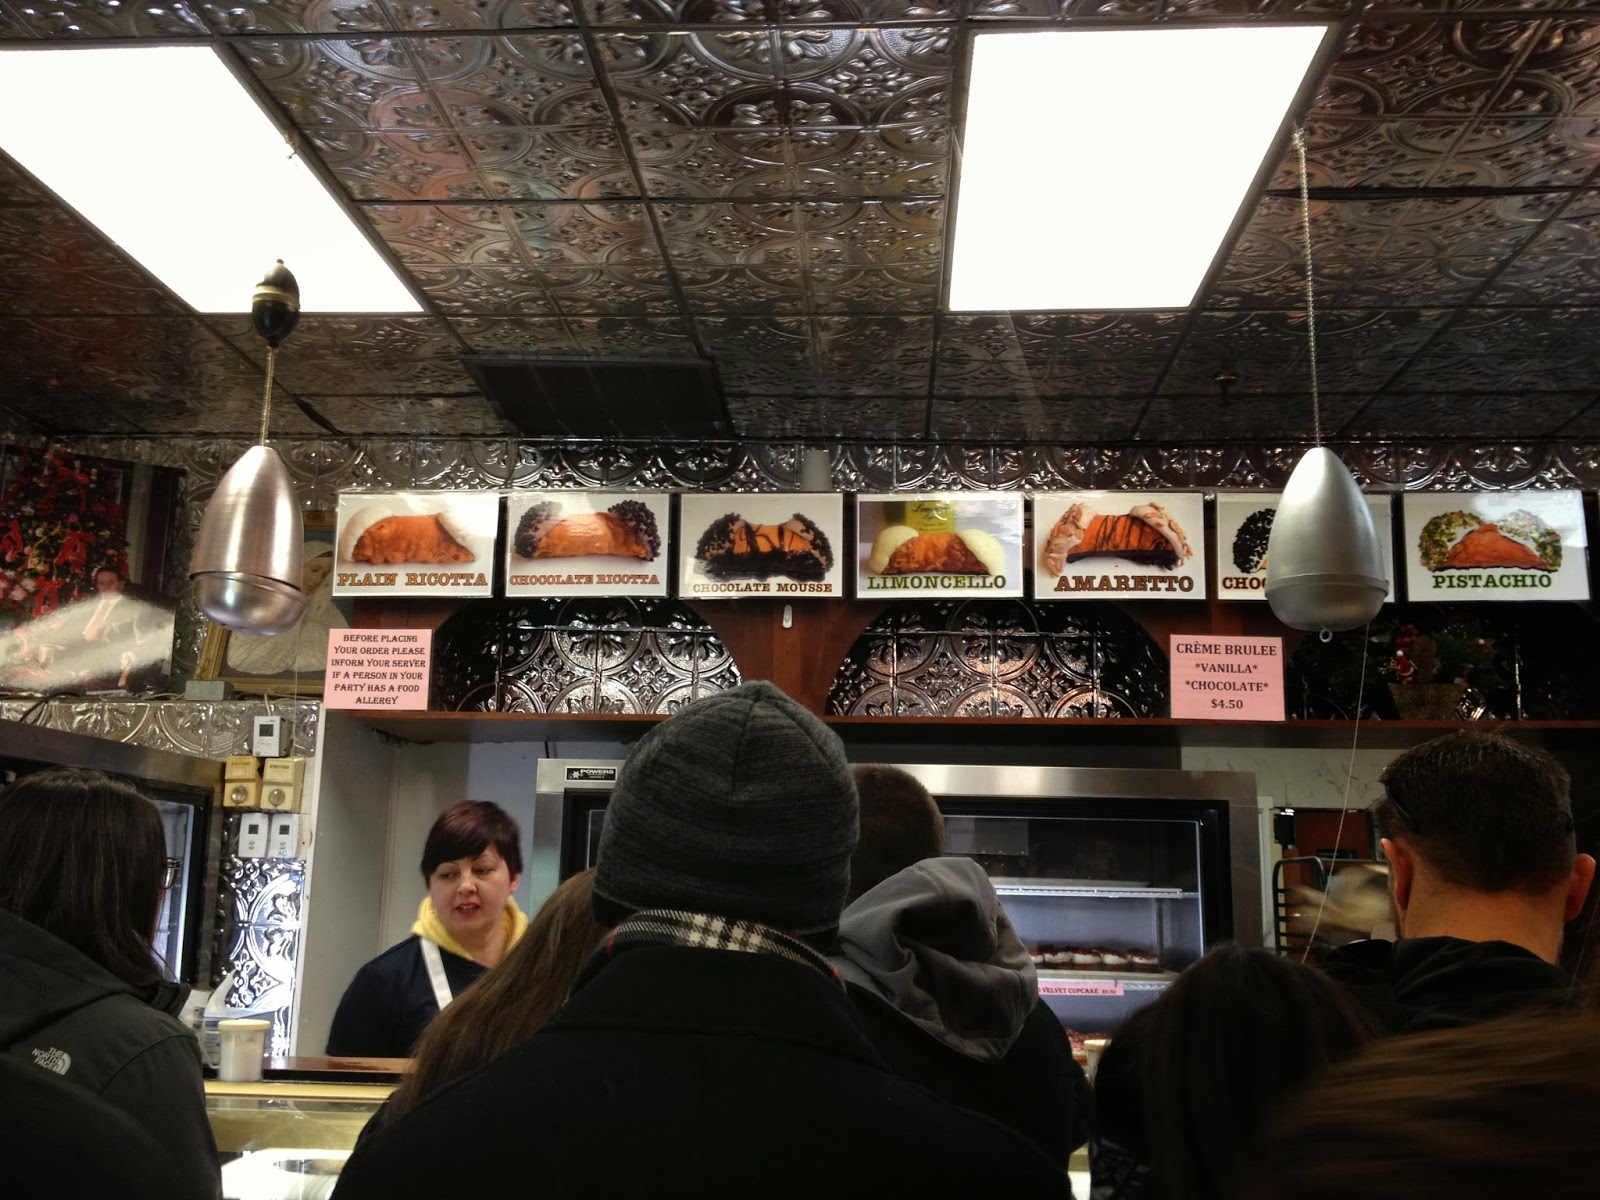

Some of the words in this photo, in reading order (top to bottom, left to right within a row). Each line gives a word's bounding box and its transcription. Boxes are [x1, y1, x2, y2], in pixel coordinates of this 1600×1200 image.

[337, 573, 398, 586] PLAIN
[405, 573, 487, 586] RICOTTA
[509, 574, 594, 586] CHOCOLATE
[596, 574, 660, 585] RICOTTA
[867, 575, 1007, 590] LIMONCELLO
[1054, 575, 1195, 593] AMARETTO
[1432, 574, 1552, 588] PISTACHIO
[692, 583, 771, 593] CHOCOLATE
[776, 583, 833, 593] MOUSSE
[343, 634, 379, 642] BEFORE
[381, 635, 418, 643] PLACING
[334, 645, 358, 654] YOUR
[360, 646, 390, 655] ORDER
[391, 647, 425, 655] PLEASE
[1176, 641, 1222, 655] CRÈME
[1225, 645, 1277, 656] BRULEE
[331, 658, 364, 667] INFORM
[366, 658, 390, 667] YOUR
[392, 659, 426, 668] SERVER
[332, 671, 341, 679] IF
[343, 671, 350, 679] A
[352, 671, 388, 680] PERSON
[389, 672, 398, 680] IN
[400, 671, 423, 680] YOUR
[334, 683, 366, 692] PARTY
[367, 684, 386, 692] HAS
[388, 684, 395, 692] A
[397, 684, 420, 692] FOOD
[355, 696, 399, 705] ALLERGY
[1211, 698, 1244, 710] $4.50
[1042, 986, 1067, 994] VELVET
[32, 1048, 60, 1063] NORTH
[49, 1047, 64, 1057] THE
[34, 1057, 55, 1070] FACE
